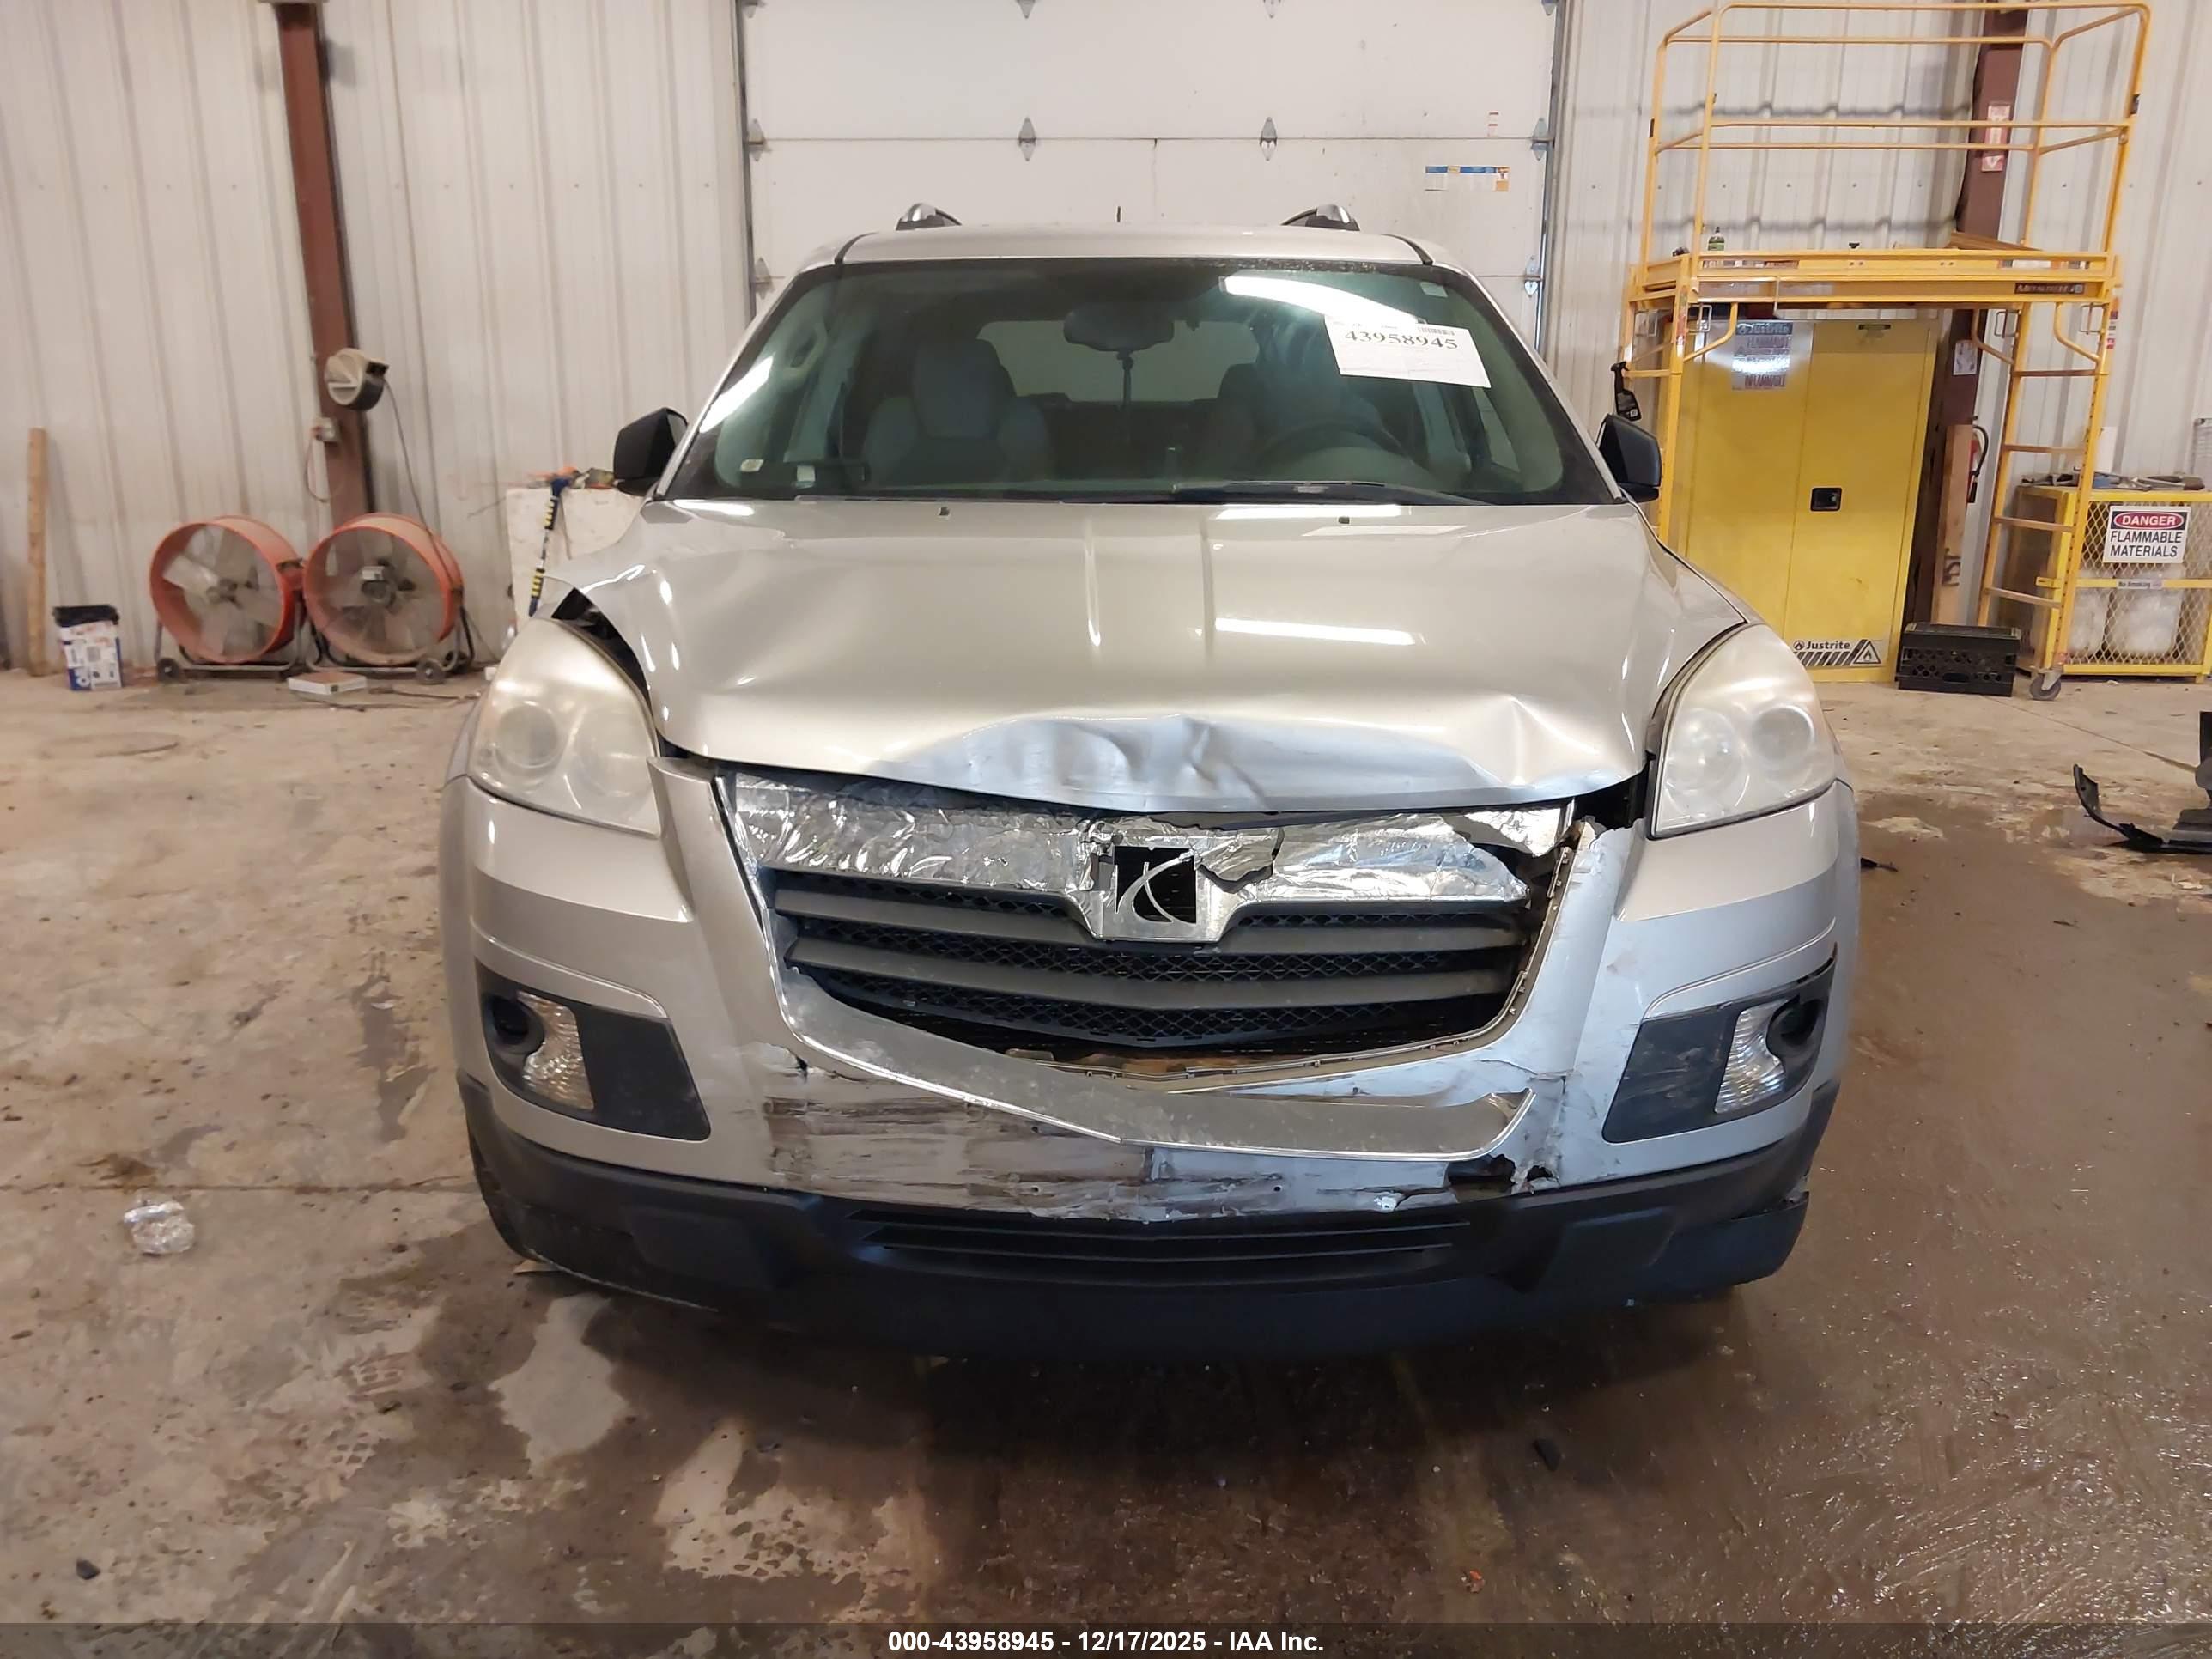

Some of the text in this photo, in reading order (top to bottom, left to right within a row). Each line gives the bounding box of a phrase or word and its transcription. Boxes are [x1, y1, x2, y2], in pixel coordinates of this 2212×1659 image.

[1345, 331, 1458, 349] 43958945
[2122, 515, 2176, 526] DANGER
[2110, 531, 2183, 543] FLAMMABLE
[2110, 545, 2179, 557] MATERIALS
[1806, 641, 1850, 650] Justrite
